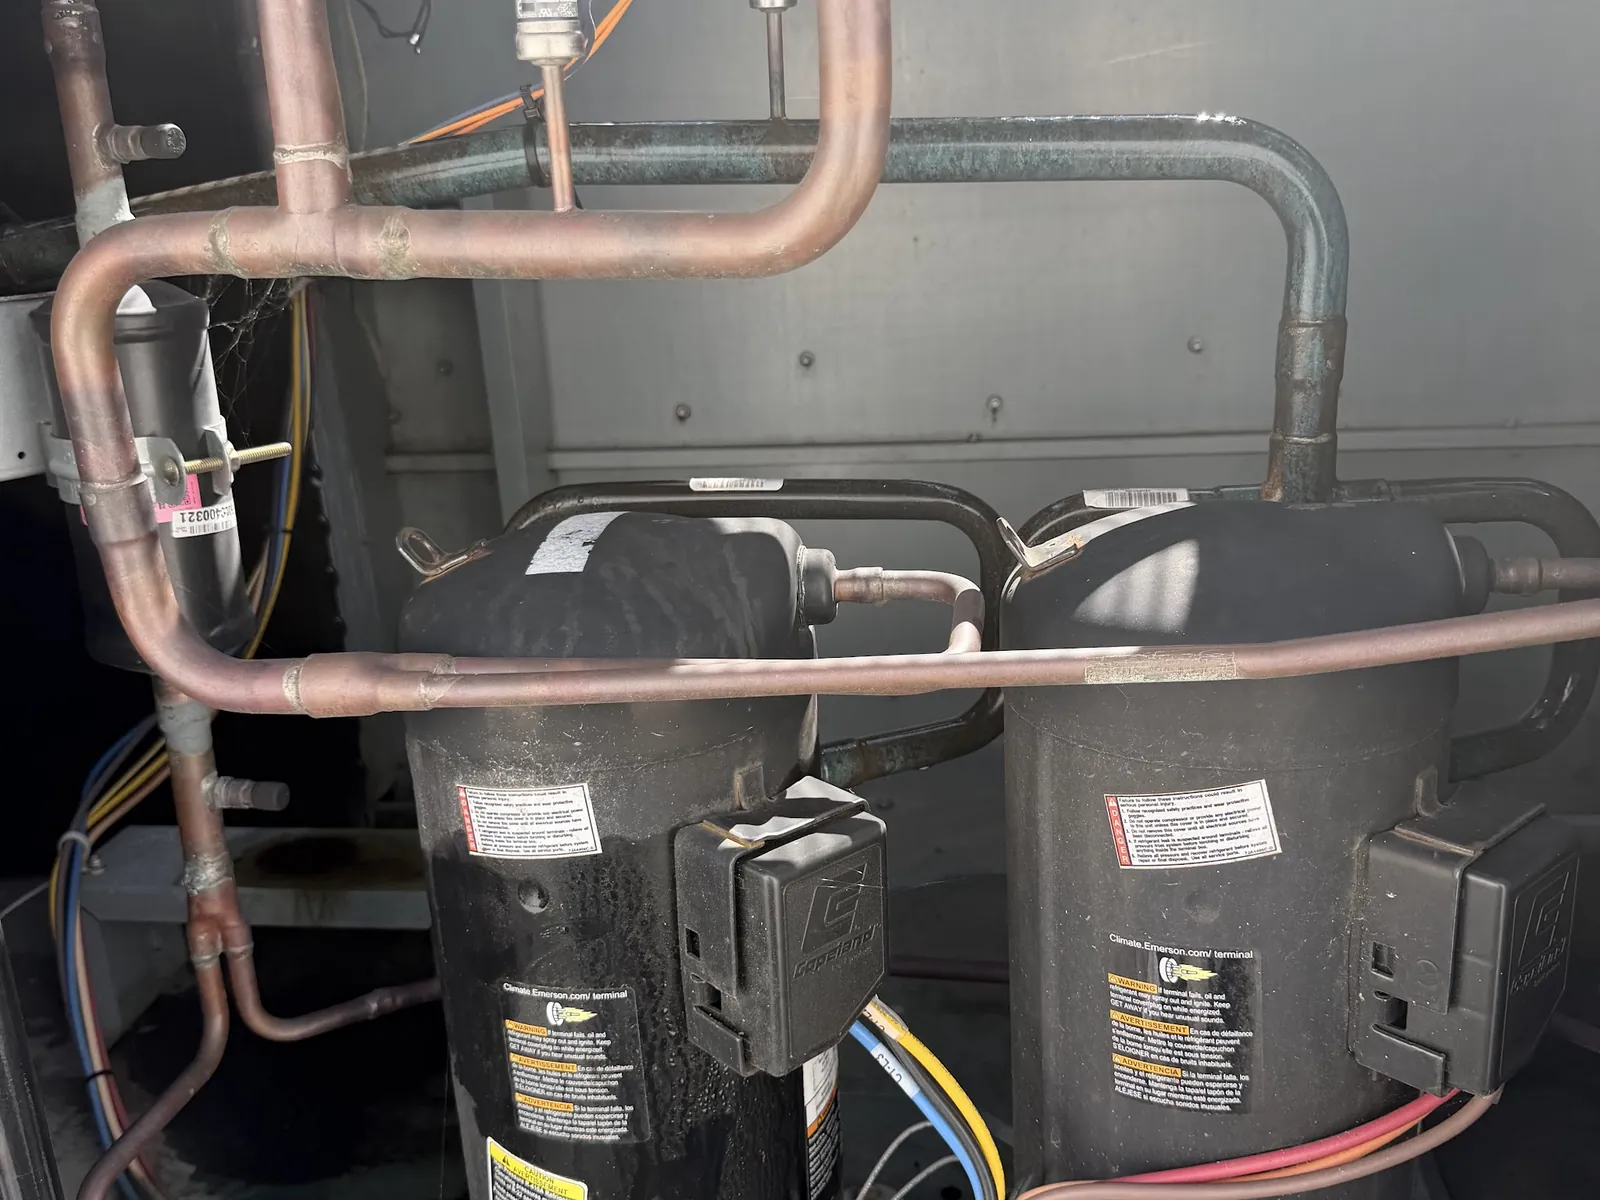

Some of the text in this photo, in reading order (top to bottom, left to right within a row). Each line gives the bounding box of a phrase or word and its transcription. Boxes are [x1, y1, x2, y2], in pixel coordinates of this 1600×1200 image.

[1112, 810, 1130, 862] DANGER
[1109, 934, 1253, 959] Climate.Emerson.com/ terminal
[503, 983, 628, 1000] Climate.Emerson.com/ terminal
[1110, 984, 1137, 996] refrigerant
[1151, 995, 1168, 1003] spray
[1118, 978, 1155, 991] WARNING
[1163, 988, 1188, 998] terminal
[1110, 999, 1123, 1007] GET
[1124, 1003, 1142, 1012] AWAY
[514, 1025, 545, 1035] WARNING
[1120, 1015, 1187, 1033] AVERTISSEMENT
[519, 1057, 575, 1070] AVERTISSEMENT
[1123, 1058, 1179, 1076] ADVERTENCIA
[524, 1097, 571, 1110] ADVERTENCIA
[525, 1166, 554, 1184] CAUTION
